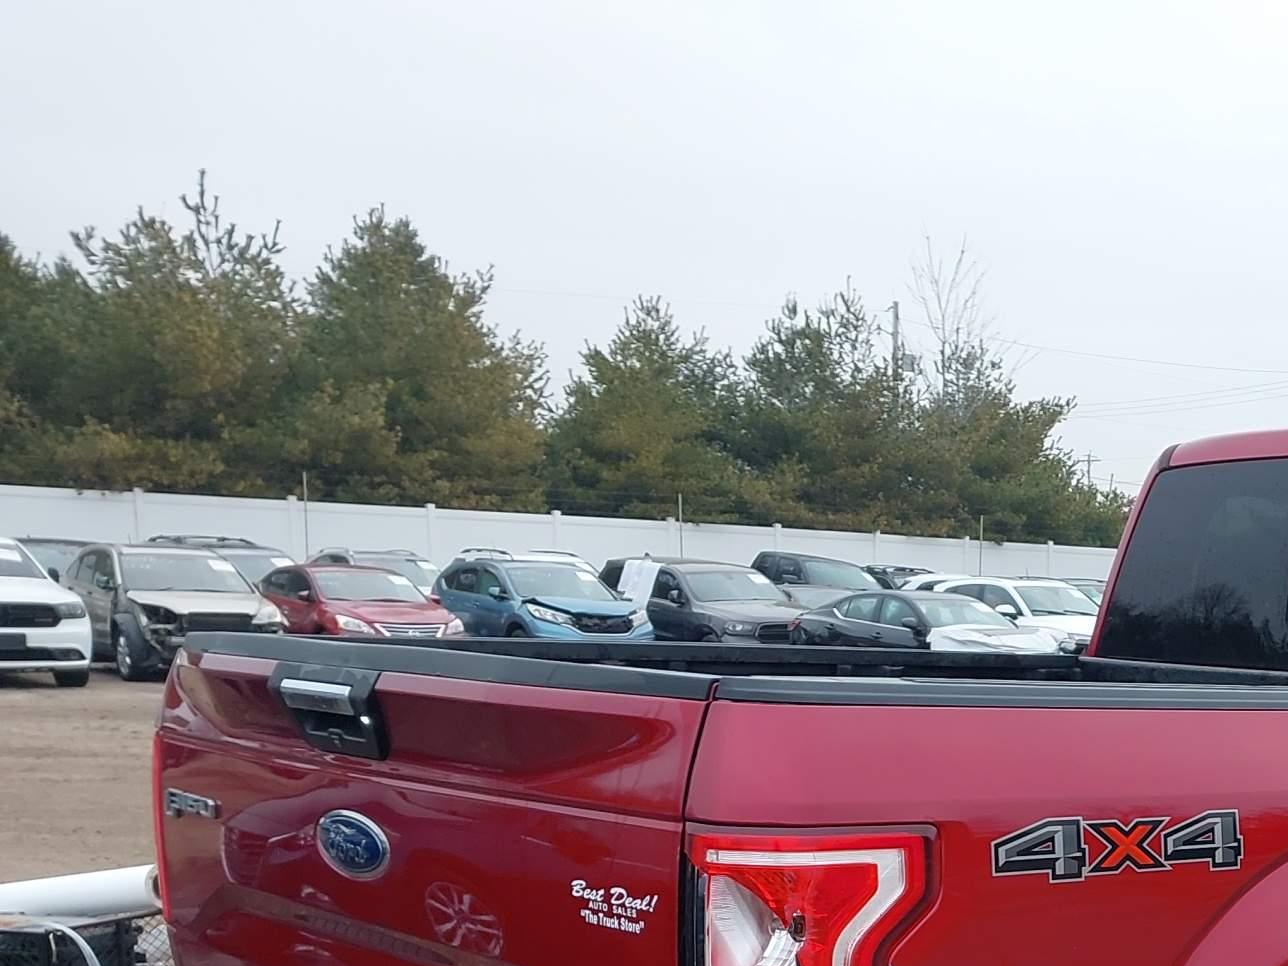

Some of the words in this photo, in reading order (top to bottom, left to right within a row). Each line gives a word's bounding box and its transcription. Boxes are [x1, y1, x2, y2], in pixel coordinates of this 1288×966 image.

[570, 879, 605, 901] Best
[610, 887, 659, 912] Deal!
[581, 908, 598, 925] "The
[598, 912, 620, 929] Truck
[620, 917, 645, 934] Store"
[588, 901, 608, 911] AUTO
[612, 905, 637, 917] SALES
